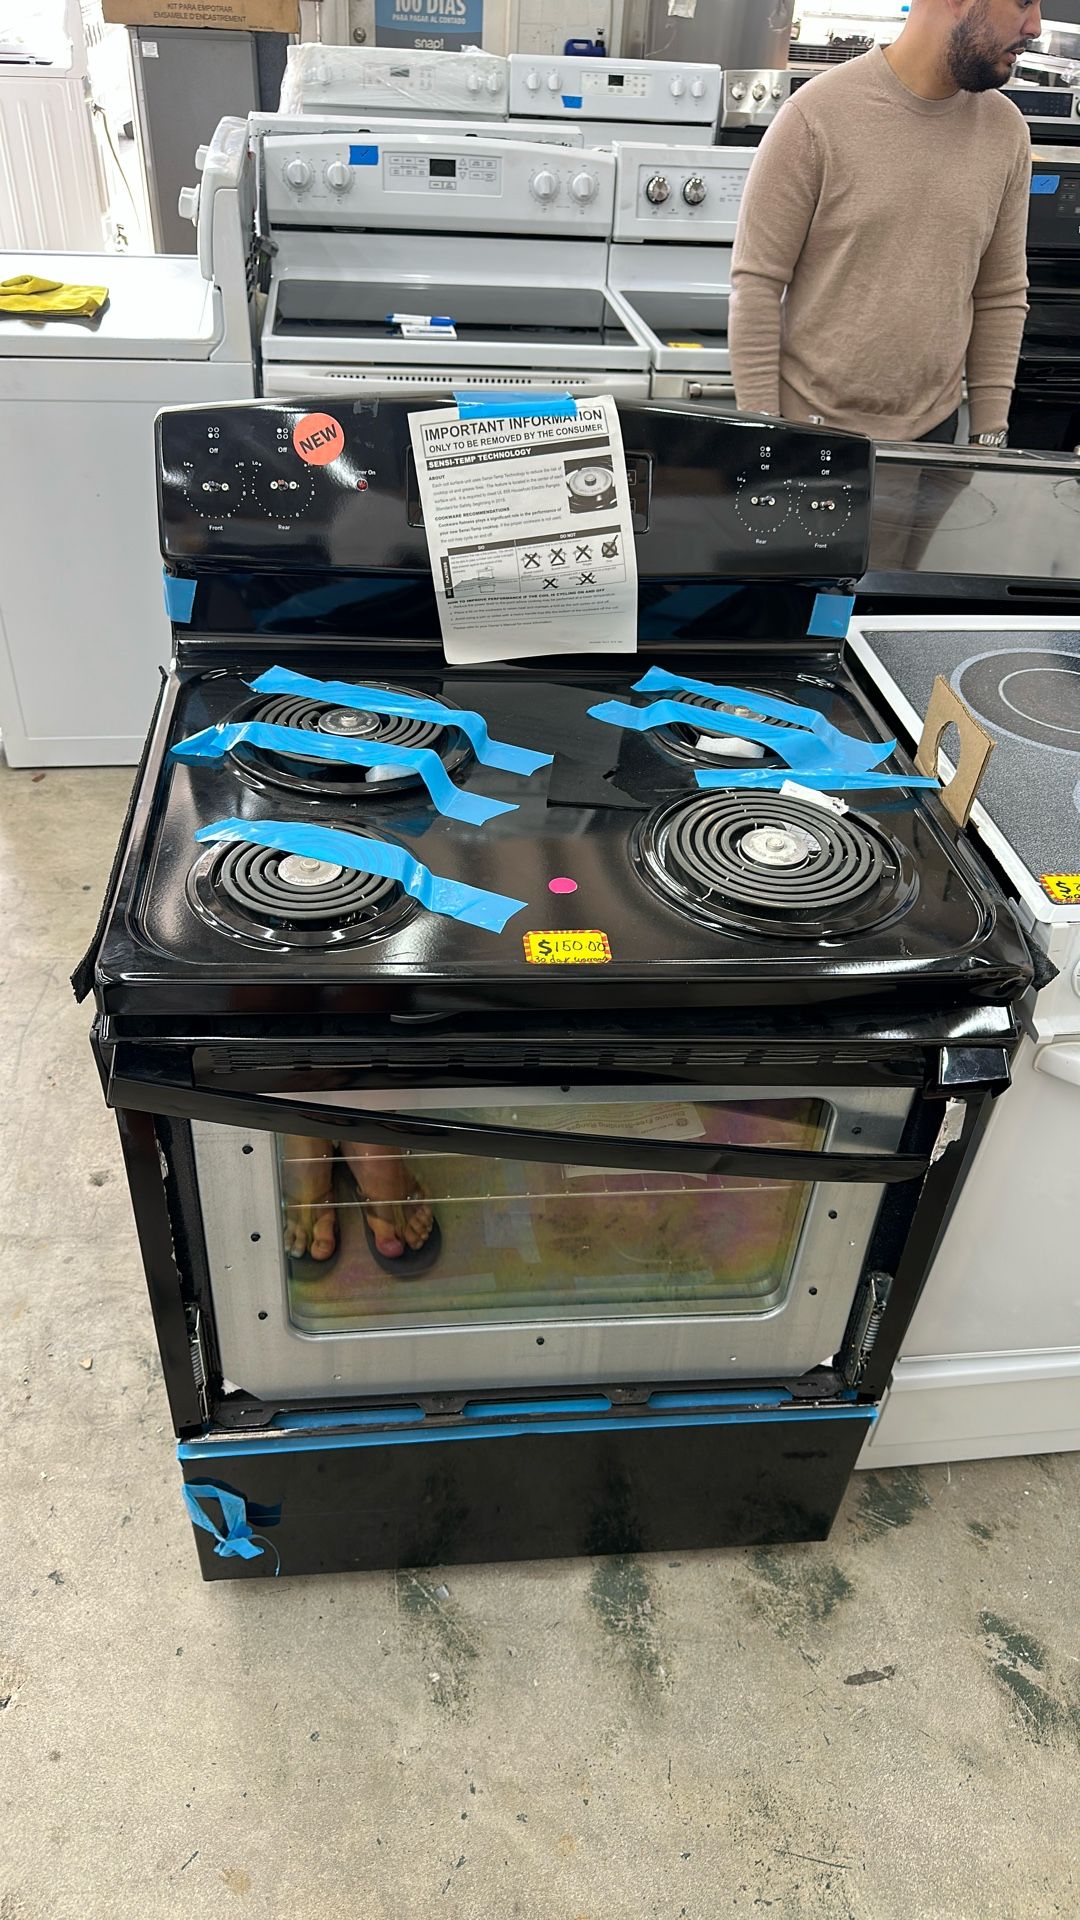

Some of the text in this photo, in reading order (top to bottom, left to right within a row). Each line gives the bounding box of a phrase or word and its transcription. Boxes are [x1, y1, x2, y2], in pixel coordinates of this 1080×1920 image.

[197, 4, 233, 13] EMPOTRAR
[395, 0, 422, 13] 100
[392, 13, 408, 21] PARA
[409, 14, 428, 22] PAGAR
[439, 16, 466, 25] CONTADO
[414, 38, 444, 50] snap!
[425, 419, 504, 441] IMPORTANT
[298, 424, 338, 455] NEW
[429, 423, 603, 453] ONLY TO BE REMOVED BY THE CONSUMER
[428, 448, 532, 468] SENSI-TEMP TECHNOLOGY
[434, 506, 509, 521] COOKWARE RECOMMENDATIONS
[655, 1110, 686, 1121] Electric
